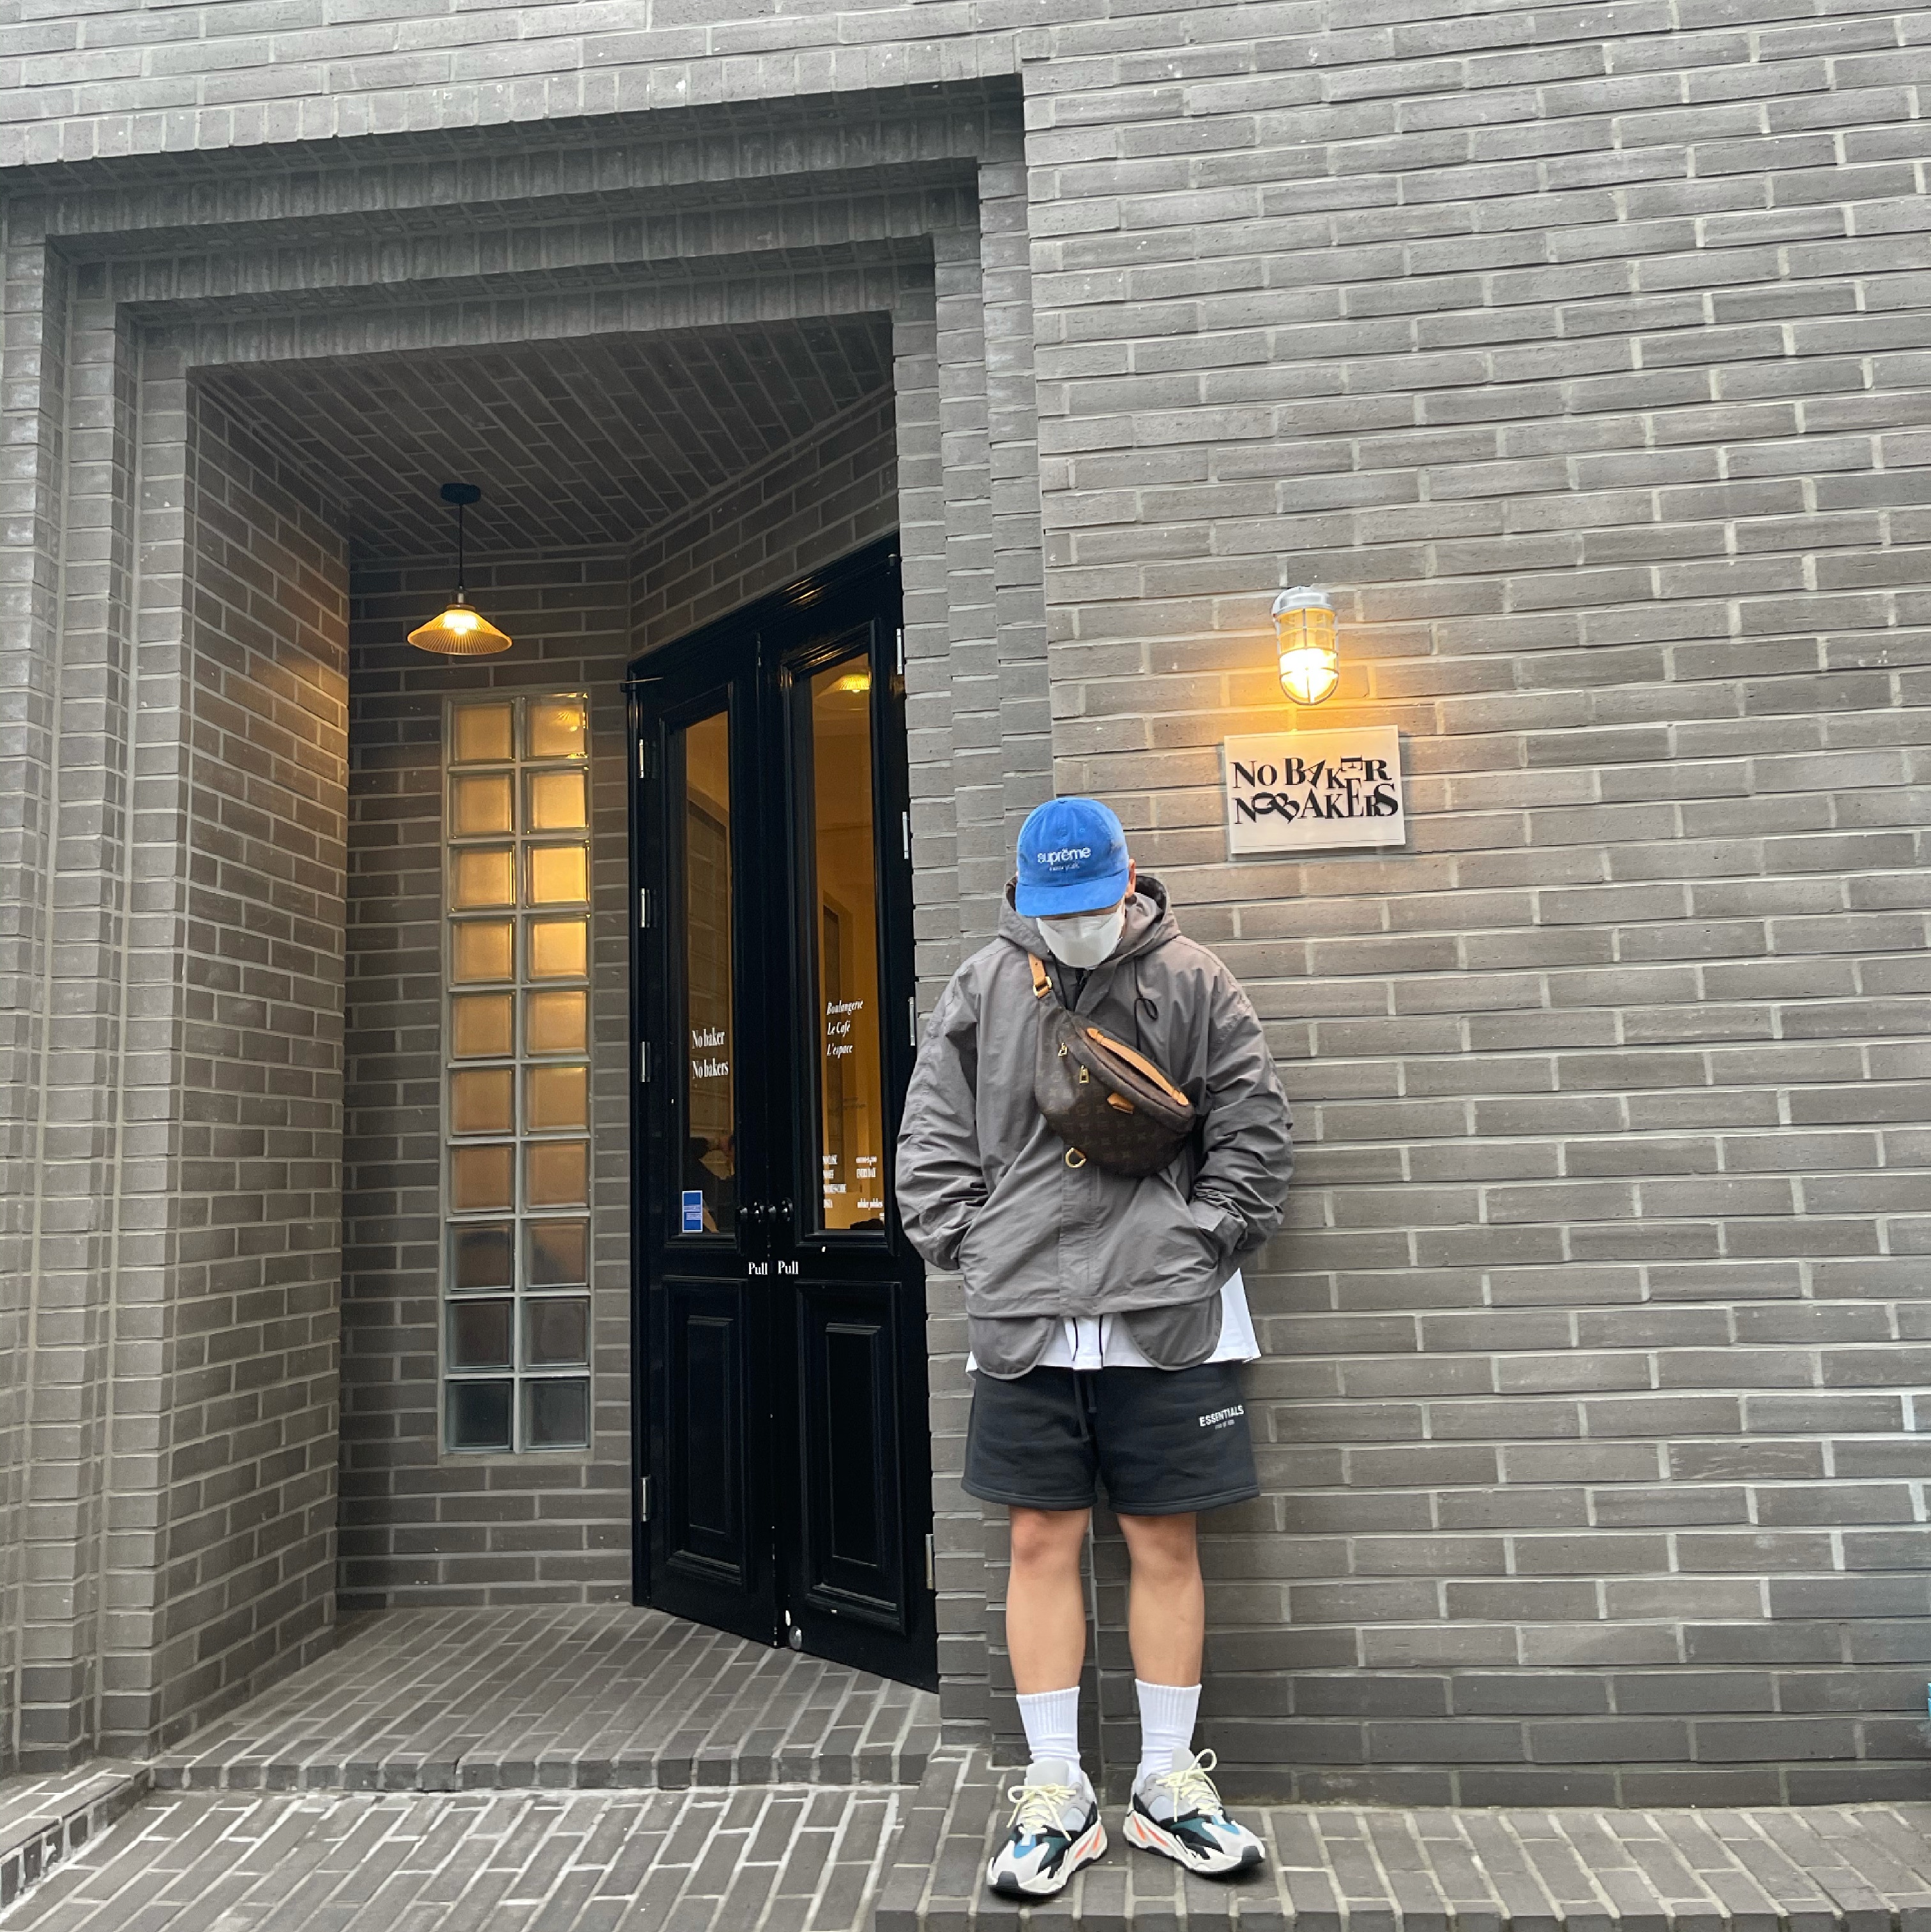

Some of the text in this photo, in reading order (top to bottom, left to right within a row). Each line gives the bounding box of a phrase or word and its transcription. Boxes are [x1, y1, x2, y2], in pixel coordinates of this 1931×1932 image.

[826, 998, 864, 1015] Boulangerie
[827, 1022, 836, 1035] Le
[692, 1026, 725, 1049] No baker
[692, 1058, 729, 1080] No bakers
[748, 1261, 768, 1275] Pull
[778, 1260, 799, 1275] Pull
[1199, 1404, 1245, 1427] ESSENTIALS
